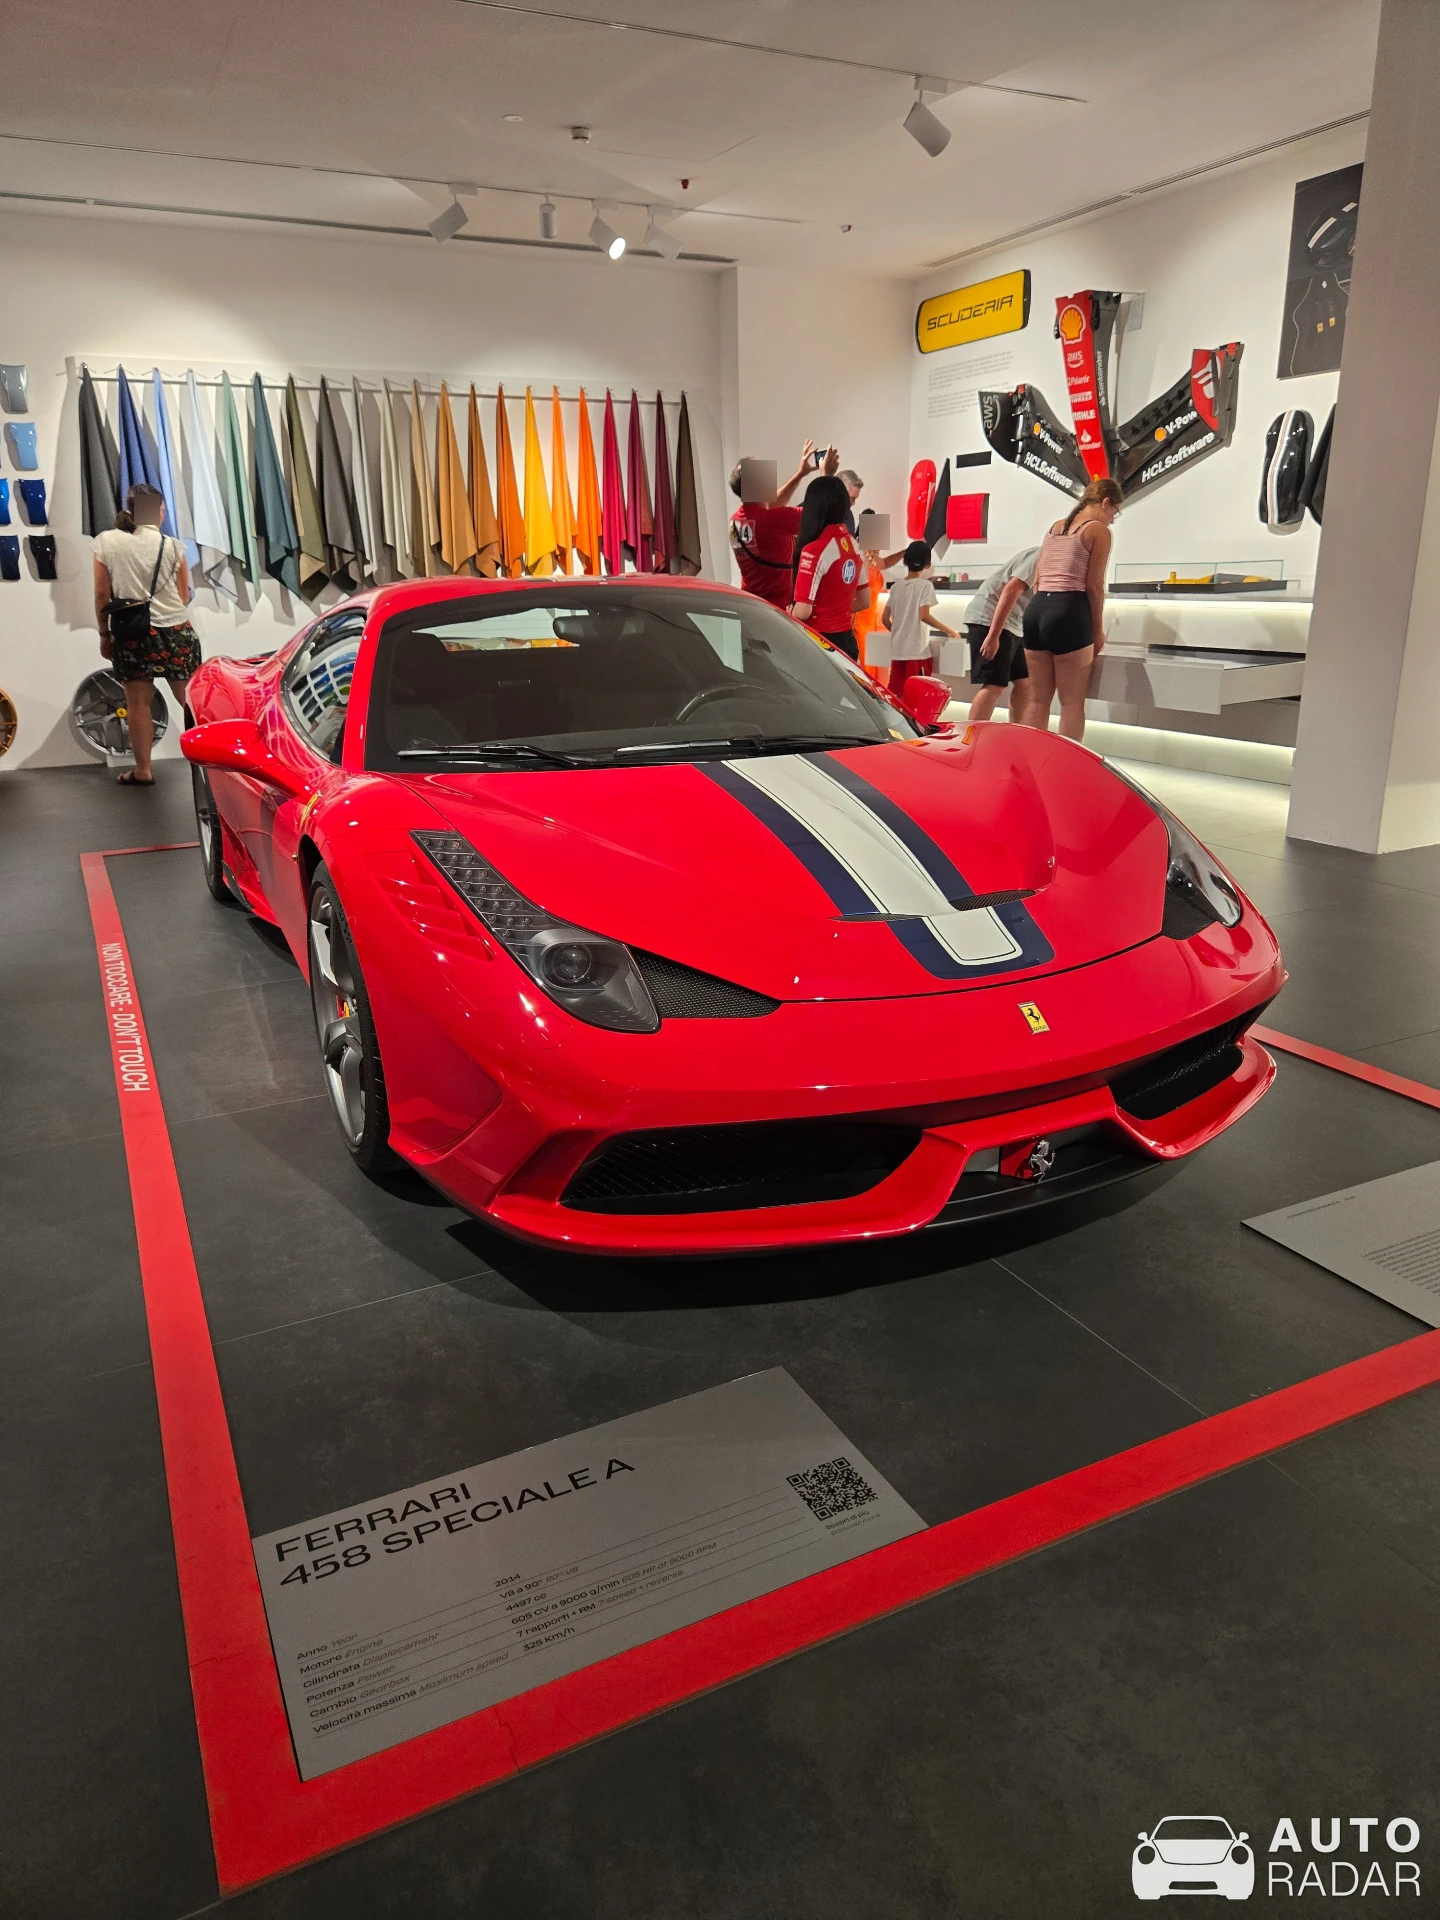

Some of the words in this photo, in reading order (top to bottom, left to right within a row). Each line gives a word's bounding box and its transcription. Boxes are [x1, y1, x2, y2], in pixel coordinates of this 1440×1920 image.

[927, 294, 1014, 331] SCUDERIA
[1067, 351, 1084, 363] aws
[1040, 428, 1063, 455] V-Power
[1142, 432, 1215, 483] HCLSoftware
[1024, 452, 1073, 489] HCLSoftware
[102, 942, 123, 962] NON
[105, 961, 133, 1008] TOCCARE
[112, 1013, 142, 1044] DON'T
[118, 1048, 150, 1092] TOUCH
[276, 1482, 471, 1562] FERRARI
[280, 1544, 371, 1586] 458
[382, 1467, 597, 1554] SPECIALE
[606, 1458, 635, 1480] A
[297, 1645, 328, 1660] Anno
[331, 1634, 358, 1648] Year
[494, 1573, 521, 1587] 2014
[300, 1654, 342, 1674] Motore
[345, 1639, 383, 1659] Engine
[500, 1589, 515, 1599] V8
[565, 1566, 579, 1576] V8
[306, 1681, 355, 1703] Potenza
[357, 1665, 395, 1685] Power
[511, 1612, 533, 1625] 605
[534, 1606, 549, 1616] CV
[559, 1592, 588, 1607] 9000
[589, 1579, 620, 1598] g/min
[621, 1572, 641, 1584] 605
[642, 1566, 657, 1576] HP
[657, 1562, 668, 1570] at
[669, 1550, 695, 1565] 9000
[695, 1542, 718, 1555] RPM
[303, 1663, 361, 1688] Cilindrata
[362, 1632, 440, 1667] Displacement
[505, 1598, 531, 1612] 4497
[309, 1696, 357, 1718] Cambio
[360, 1675, 411, 1700] Gearbox
[516, 1630, 523, 1638] 7
[525, 1613, 570, 1634] rapporti
[579, 1603, 596, 1614] RM
[645, 1570, 684, 1590] reverse
[313, 1709, 362, 1733] Velocità
[363, 1689, 417, 1716] massima
[418, 1667, 475, 1694] Maximum
[475, 1652, 510, 1672] speed
[522, 1639, 543, 1652] 325
[544, 1627, 576, 1643] Km/h
